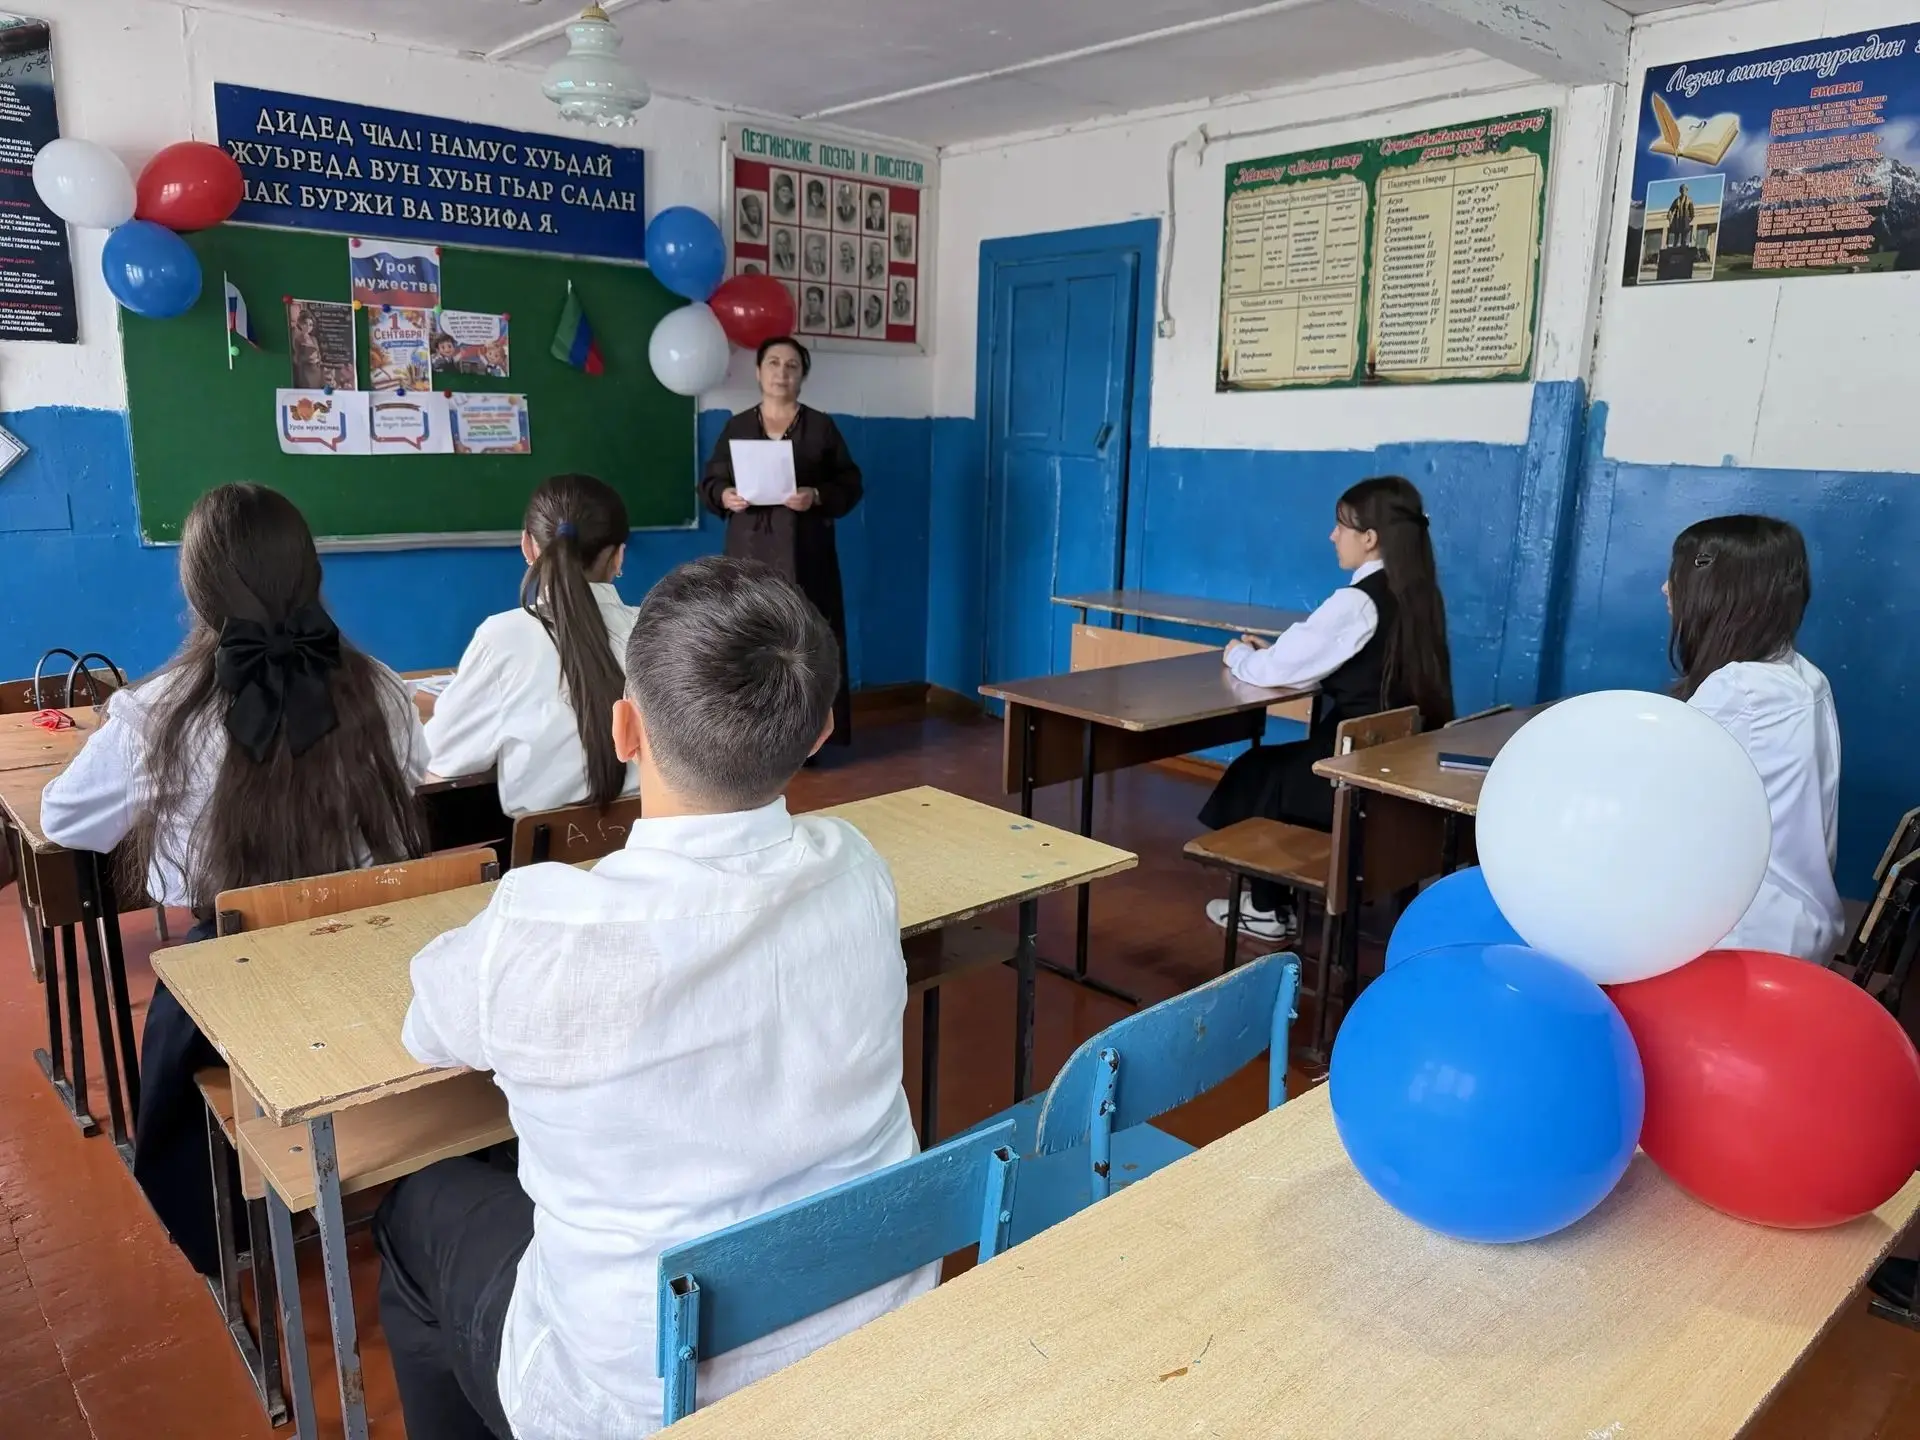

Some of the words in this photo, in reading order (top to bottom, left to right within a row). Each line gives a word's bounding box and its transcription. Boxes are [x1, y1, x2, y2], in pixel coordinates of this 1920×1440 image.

[1726, 34, 1906, 85] литературадин
[256, 107, 354, 146] ДИДЕД
[430, 133, 517, 165] НАМУС
[524, 147, 613, 178] ХУЬДАЙ
[741, 128, 813, 163] ЛЕЗГИНСКИЕ
[819, 144, 856, 171] ПОЭТЫ
[861, 152, 869, 173] И
[874, 154, 925, 184] ПИСАТЕЛИ
[228, 140, 363, 180] ЖУЬРЕДА
[369, 158, 422, 186] ВУН
[428, 166, 493, 195] ХУЬН
[500, 176, 554, 201] ГЬАР
[561, 184, 636, 212] САДАН
[300, 185, 395, 217] БУРЖИ
[401, 197, 434, 221] ВА
[440, 201, 534, 232] ВЕЗИФА
[538, 213, 559, 234] Я.
[354, 277, 438, 293] мужества
[373, 257, 417, 275] Урок
[388, 313, 401, 330] 1
